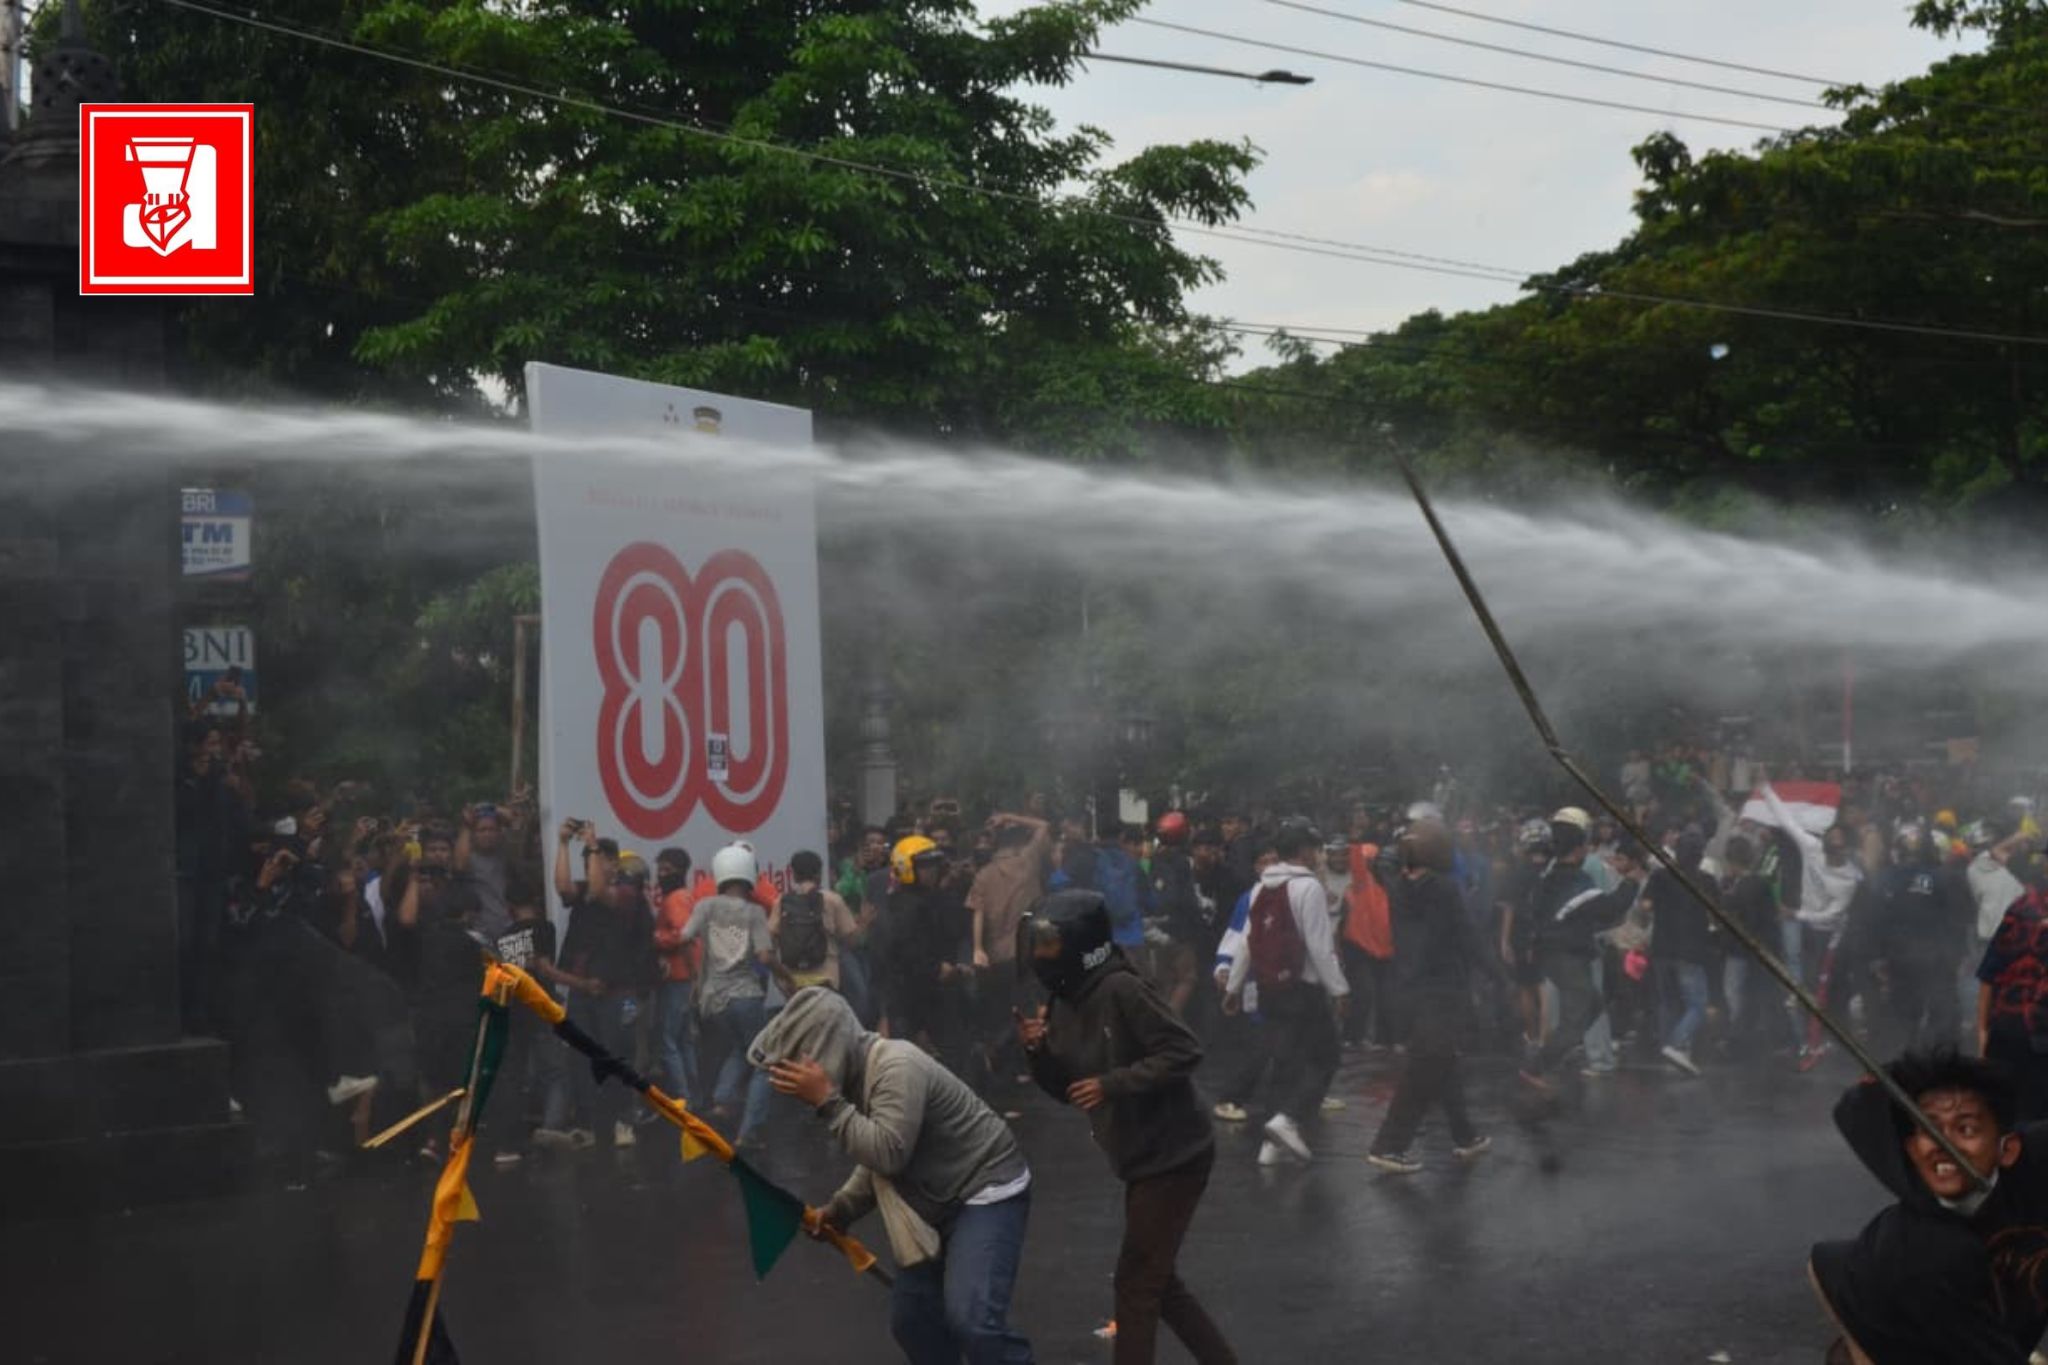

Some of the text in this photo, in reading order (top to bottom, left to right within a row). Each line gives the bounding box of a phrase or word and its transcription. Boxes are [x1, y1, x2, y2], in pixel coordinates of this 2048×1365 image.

[182, 494, 216, 513] BRI
[181, 522, 233, 544] TM
[594, 542, 787, 839] 80
